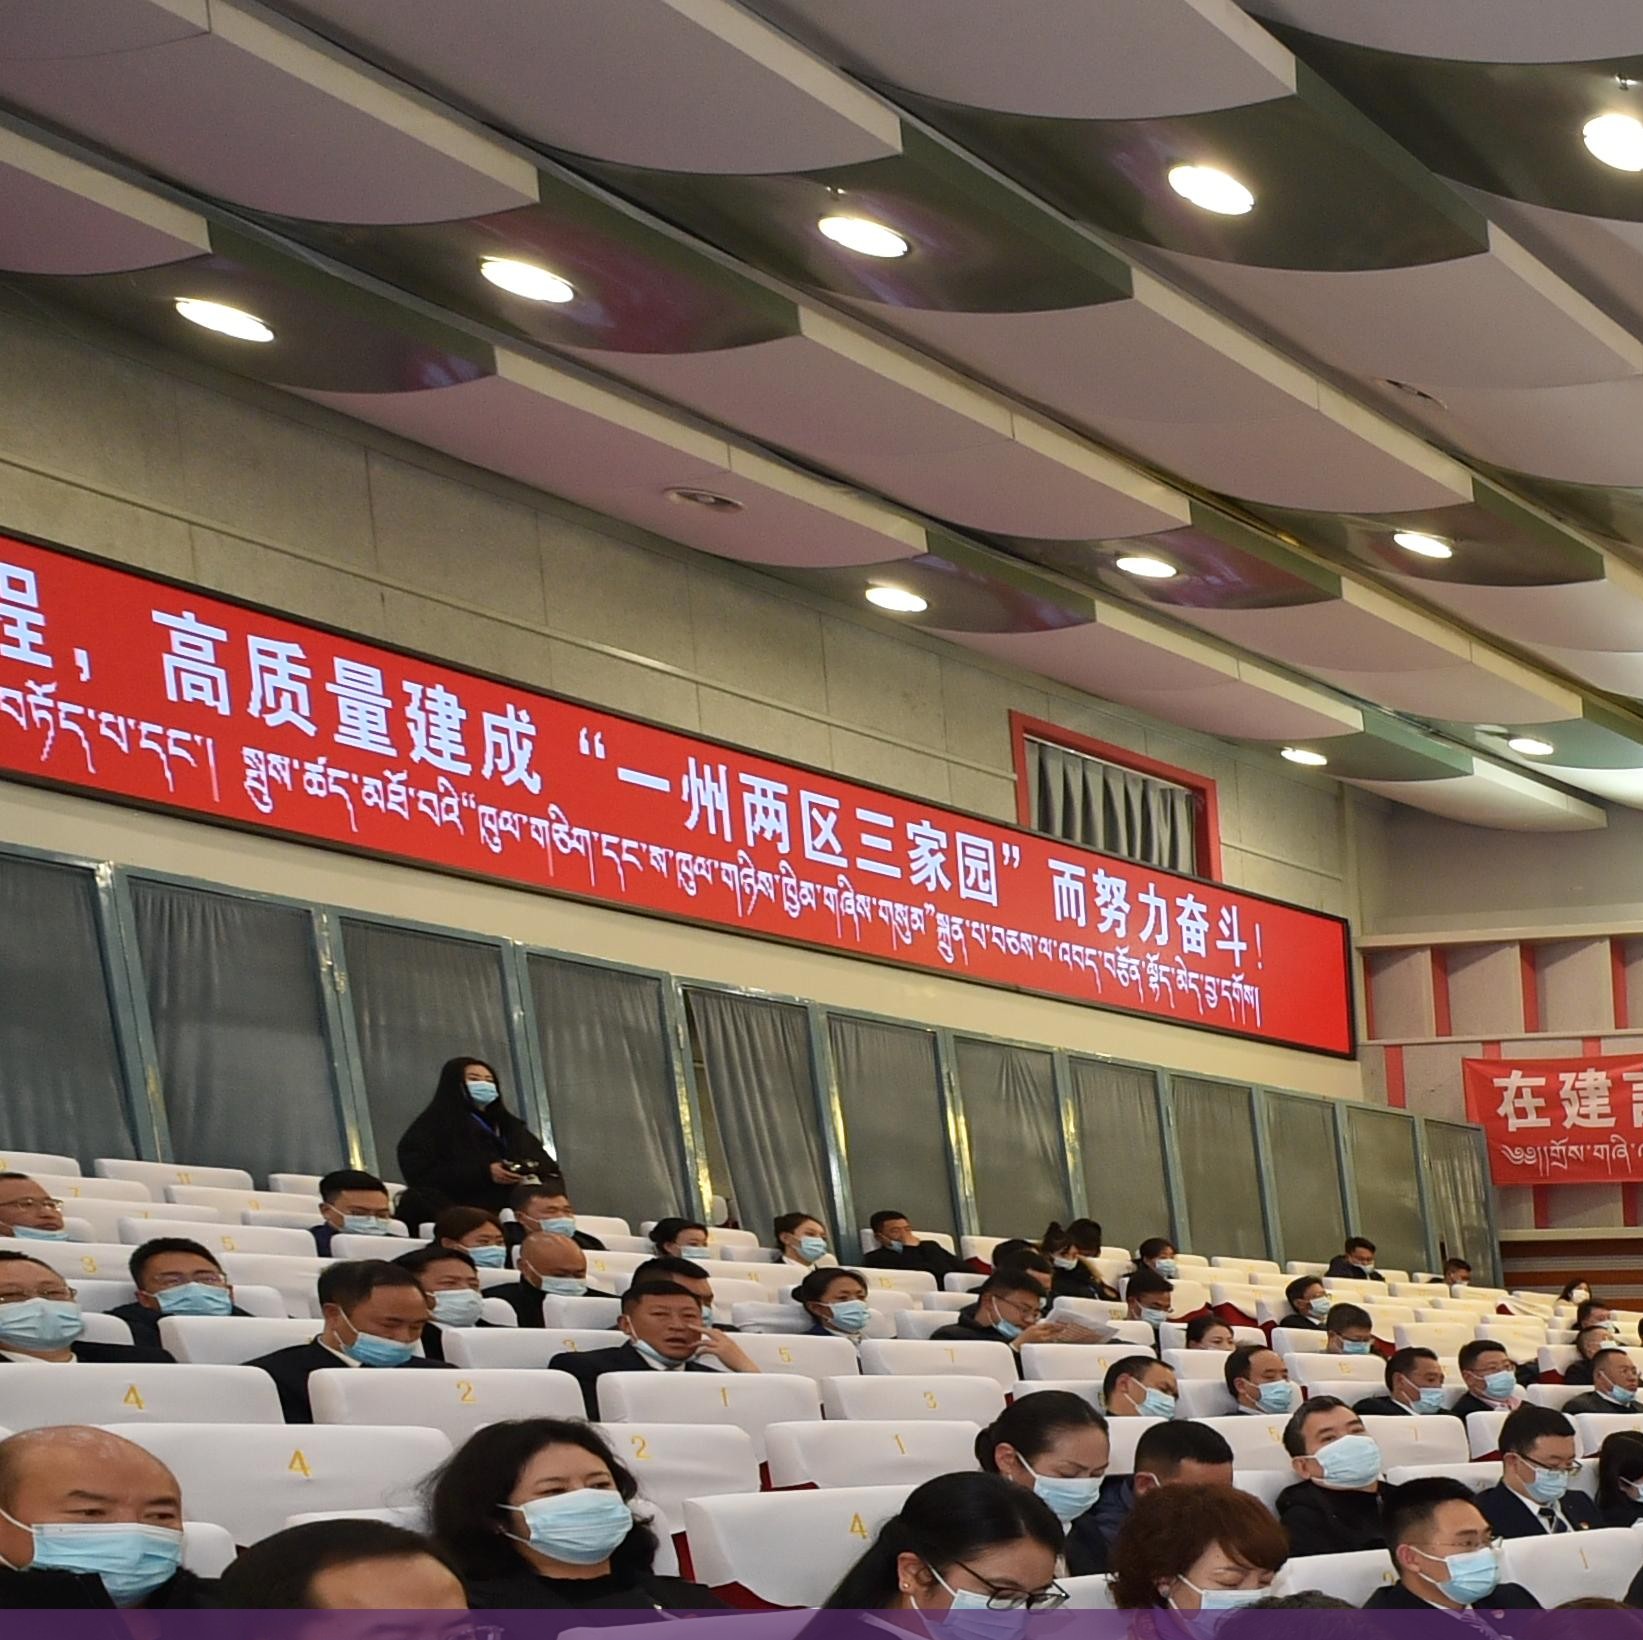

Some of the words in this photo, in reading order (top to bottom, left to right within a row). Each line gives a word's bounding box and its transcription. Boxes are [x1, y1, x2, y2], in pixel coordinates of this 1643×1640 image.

[80, 1255, 97, 1273] 3
[778, 1346, 792, 1362] 5
[122, 1384, 144, 1410] 4
[456, 1381, 476, 1404] 2
[721, 1387, 729, 1407] 1
[923, 1392, 937, 1408] 3
[630, 1436, 650, 1458] 2
[287, 1450, 311, 1477] 4
[850, 1512, 869, 1540] 4
